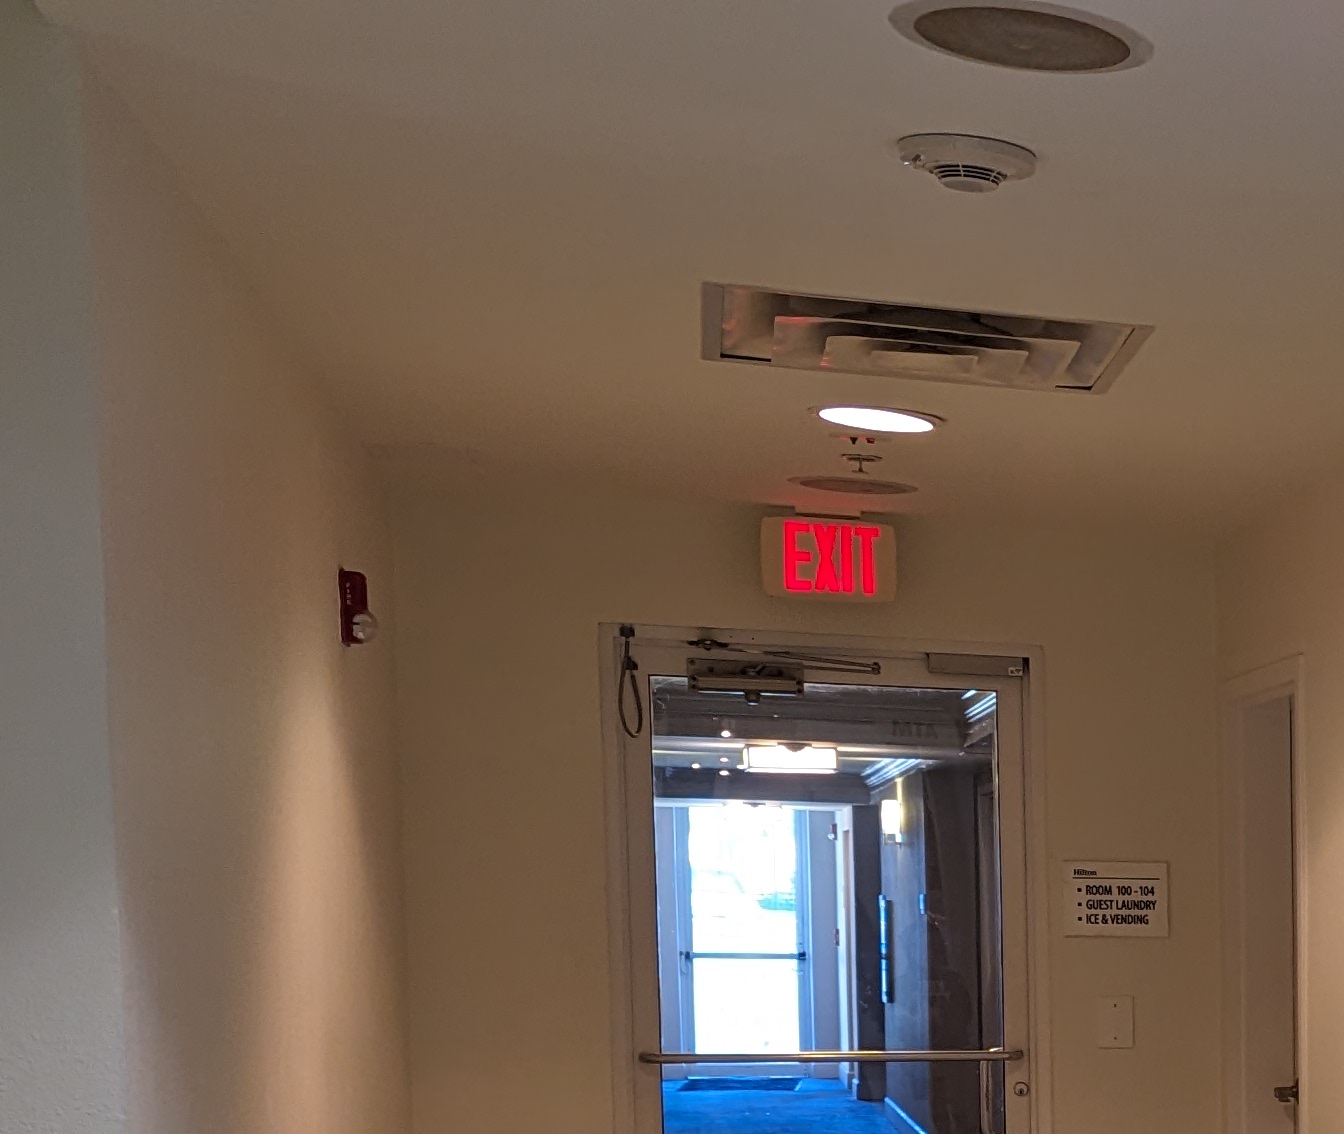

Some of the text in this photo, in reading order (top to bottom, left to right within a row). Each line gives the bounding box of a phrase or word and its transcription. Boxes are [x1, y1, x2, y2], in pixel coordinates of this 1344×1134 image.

[784, 521, 881, 595] EXIT
[1085, 885, 1112, 896] ROOM
[1116, 886, 1132, 896] 100
[1139, 886, 1155, 896] 104
[1086, 899, 1157, 910] GUEST LAUNDRY
[1086, 914, 1149, 925] ICE & VENDING
